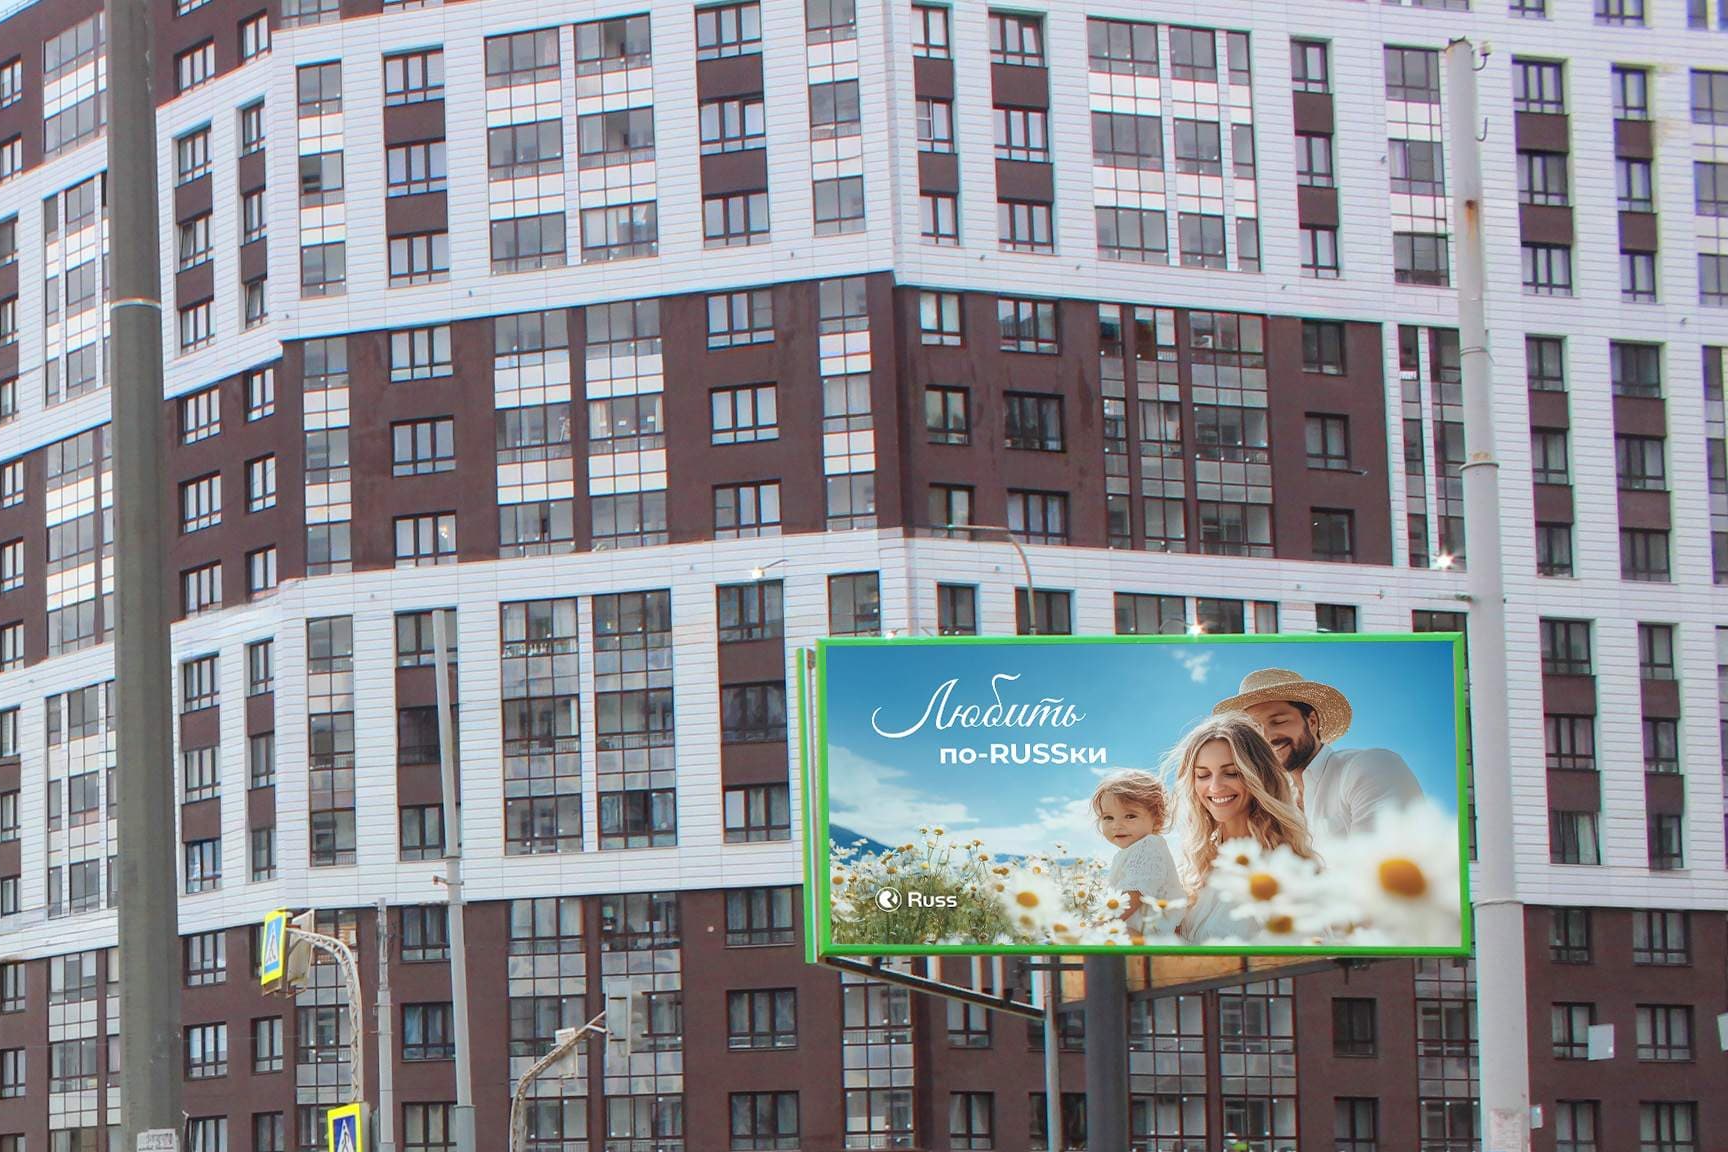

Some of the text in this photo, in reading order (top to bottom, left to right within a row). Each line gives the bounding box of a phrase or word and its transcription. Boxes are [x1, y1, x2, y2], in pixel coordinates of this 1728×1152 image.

[871, 673, 1087, 738] Любить
[940, 743, 1107, 764] по-RUSSки
[908, 891, 958, 908] Russ
